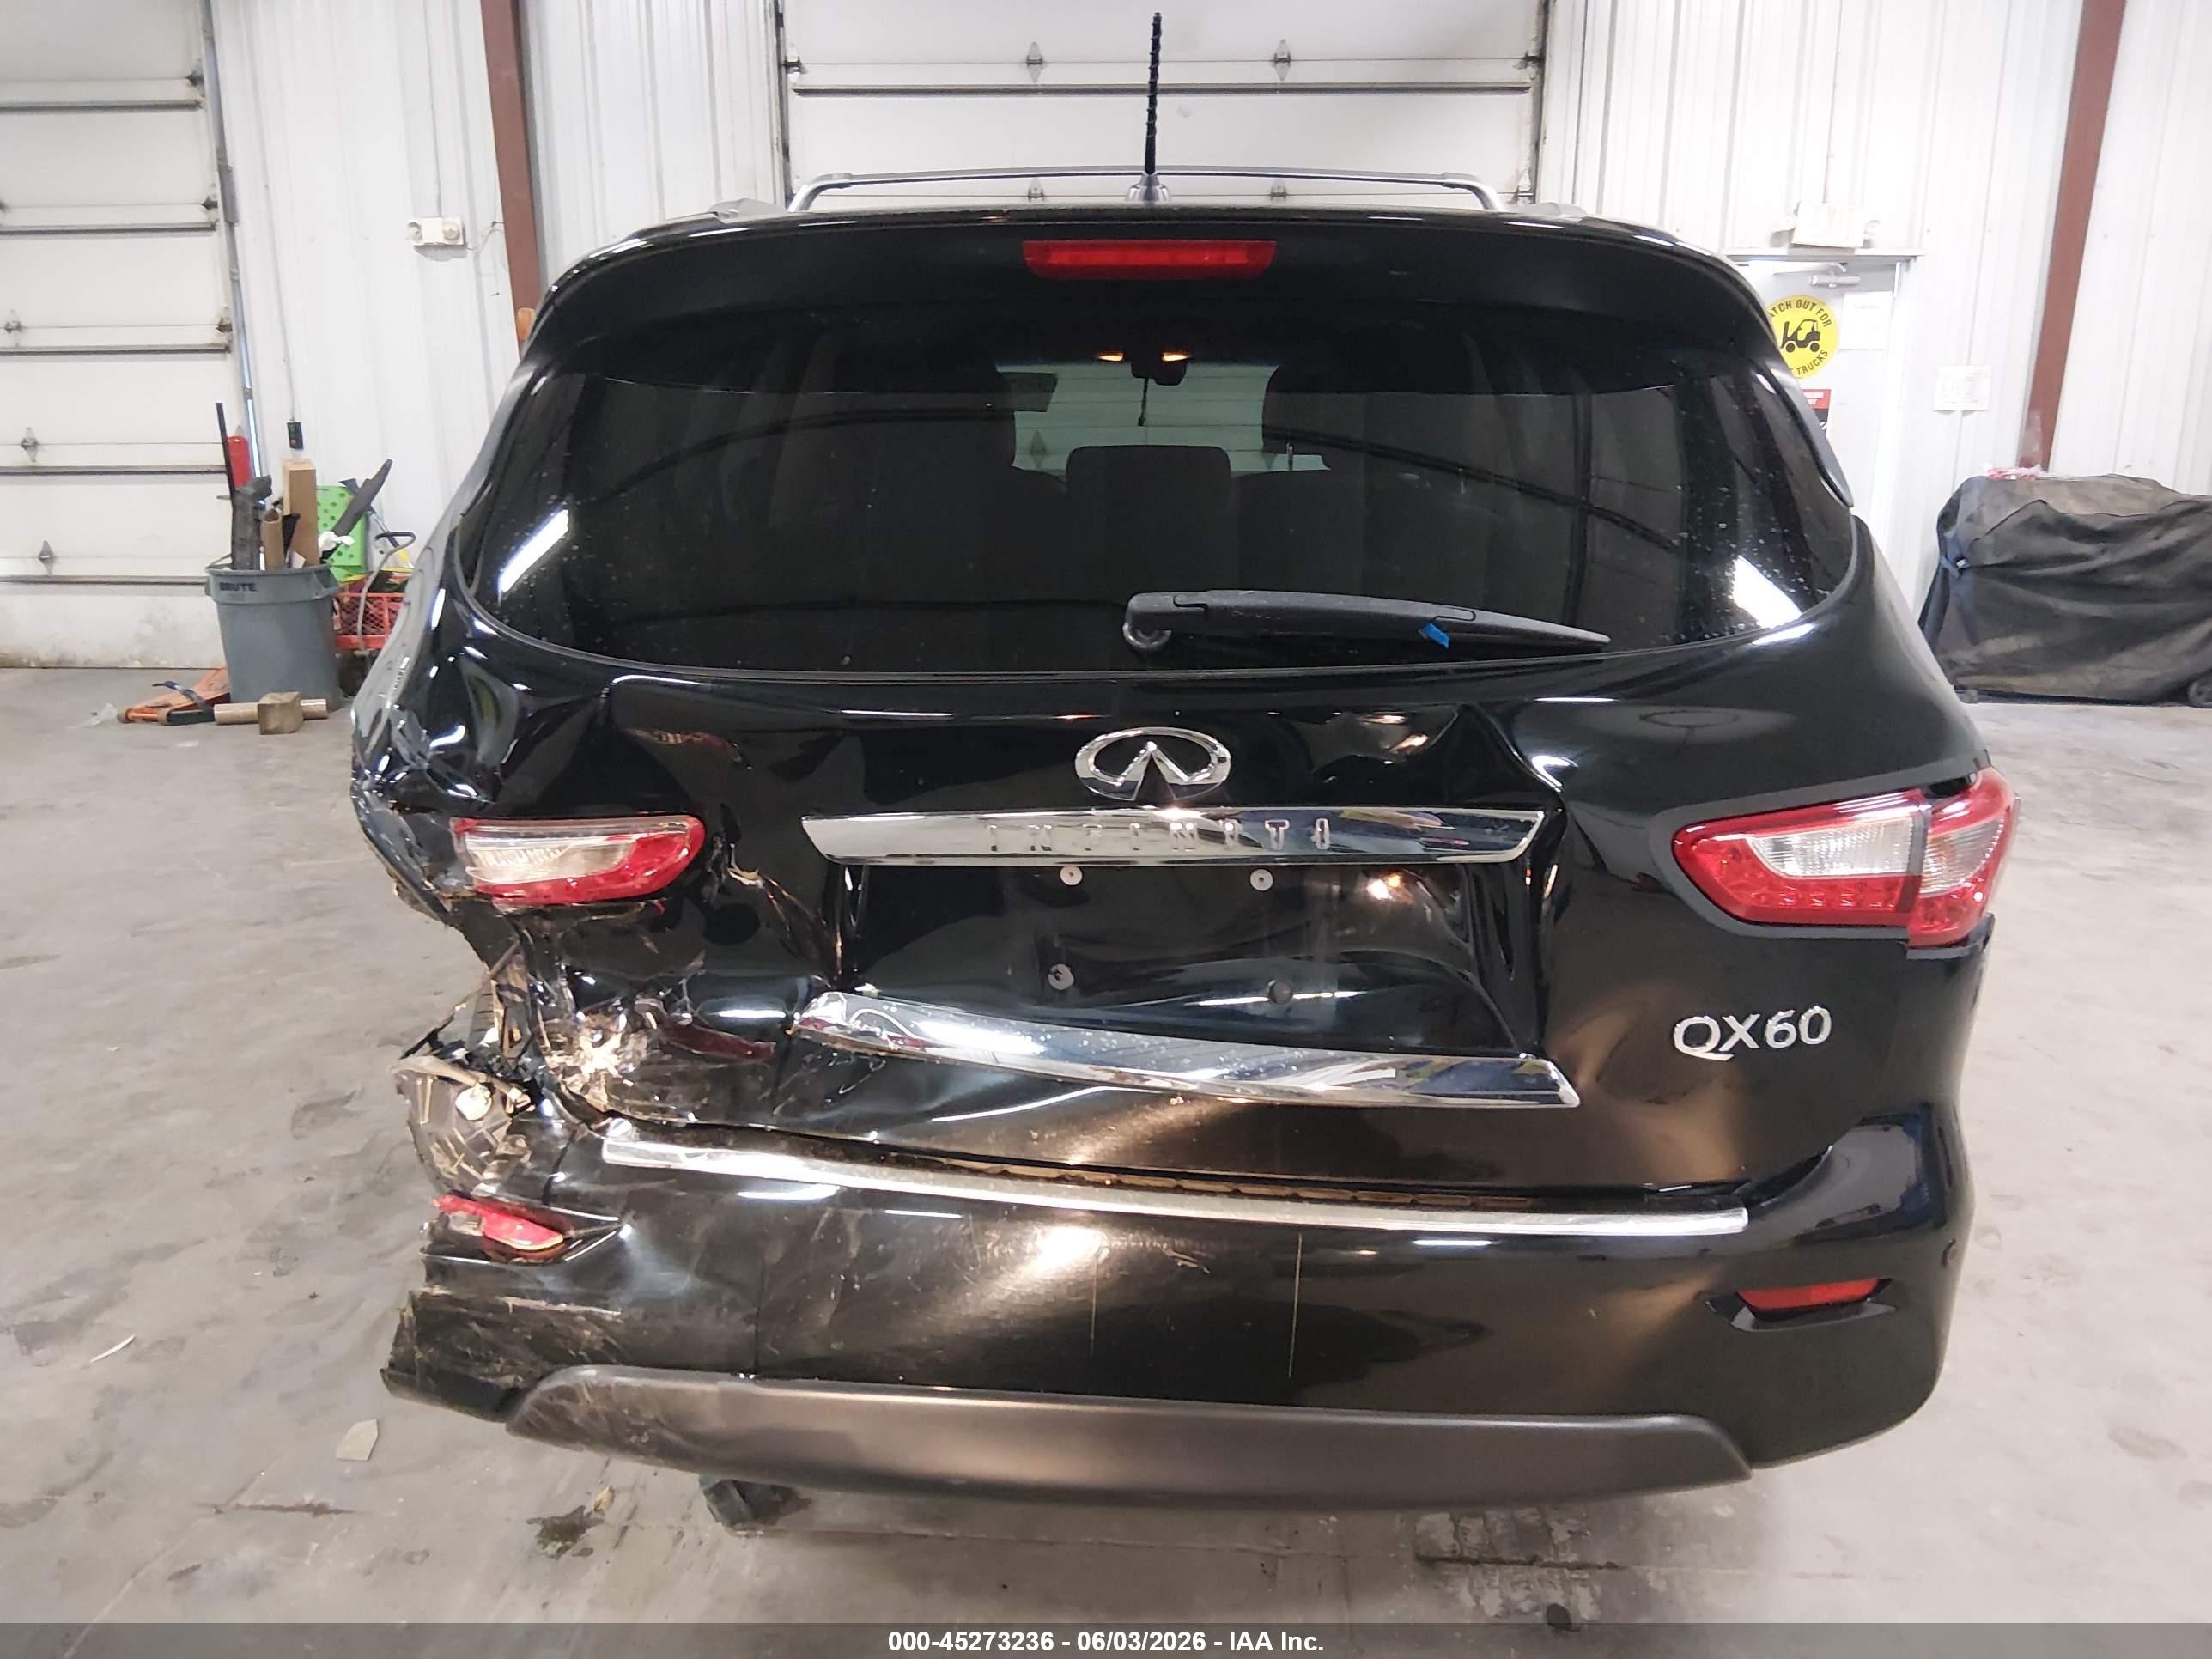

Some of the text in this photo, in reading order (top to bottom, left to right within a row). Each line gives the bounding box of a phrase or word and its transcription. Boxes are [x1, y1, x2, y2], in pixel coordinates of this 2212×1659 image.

[1796, 299, 1817, 311] OUT
[1815, 308, 1832, 327] FOR
[1796, 349, 1828, 375] TRUCKS
[1674, 1006, 1832, 1062] QX60
